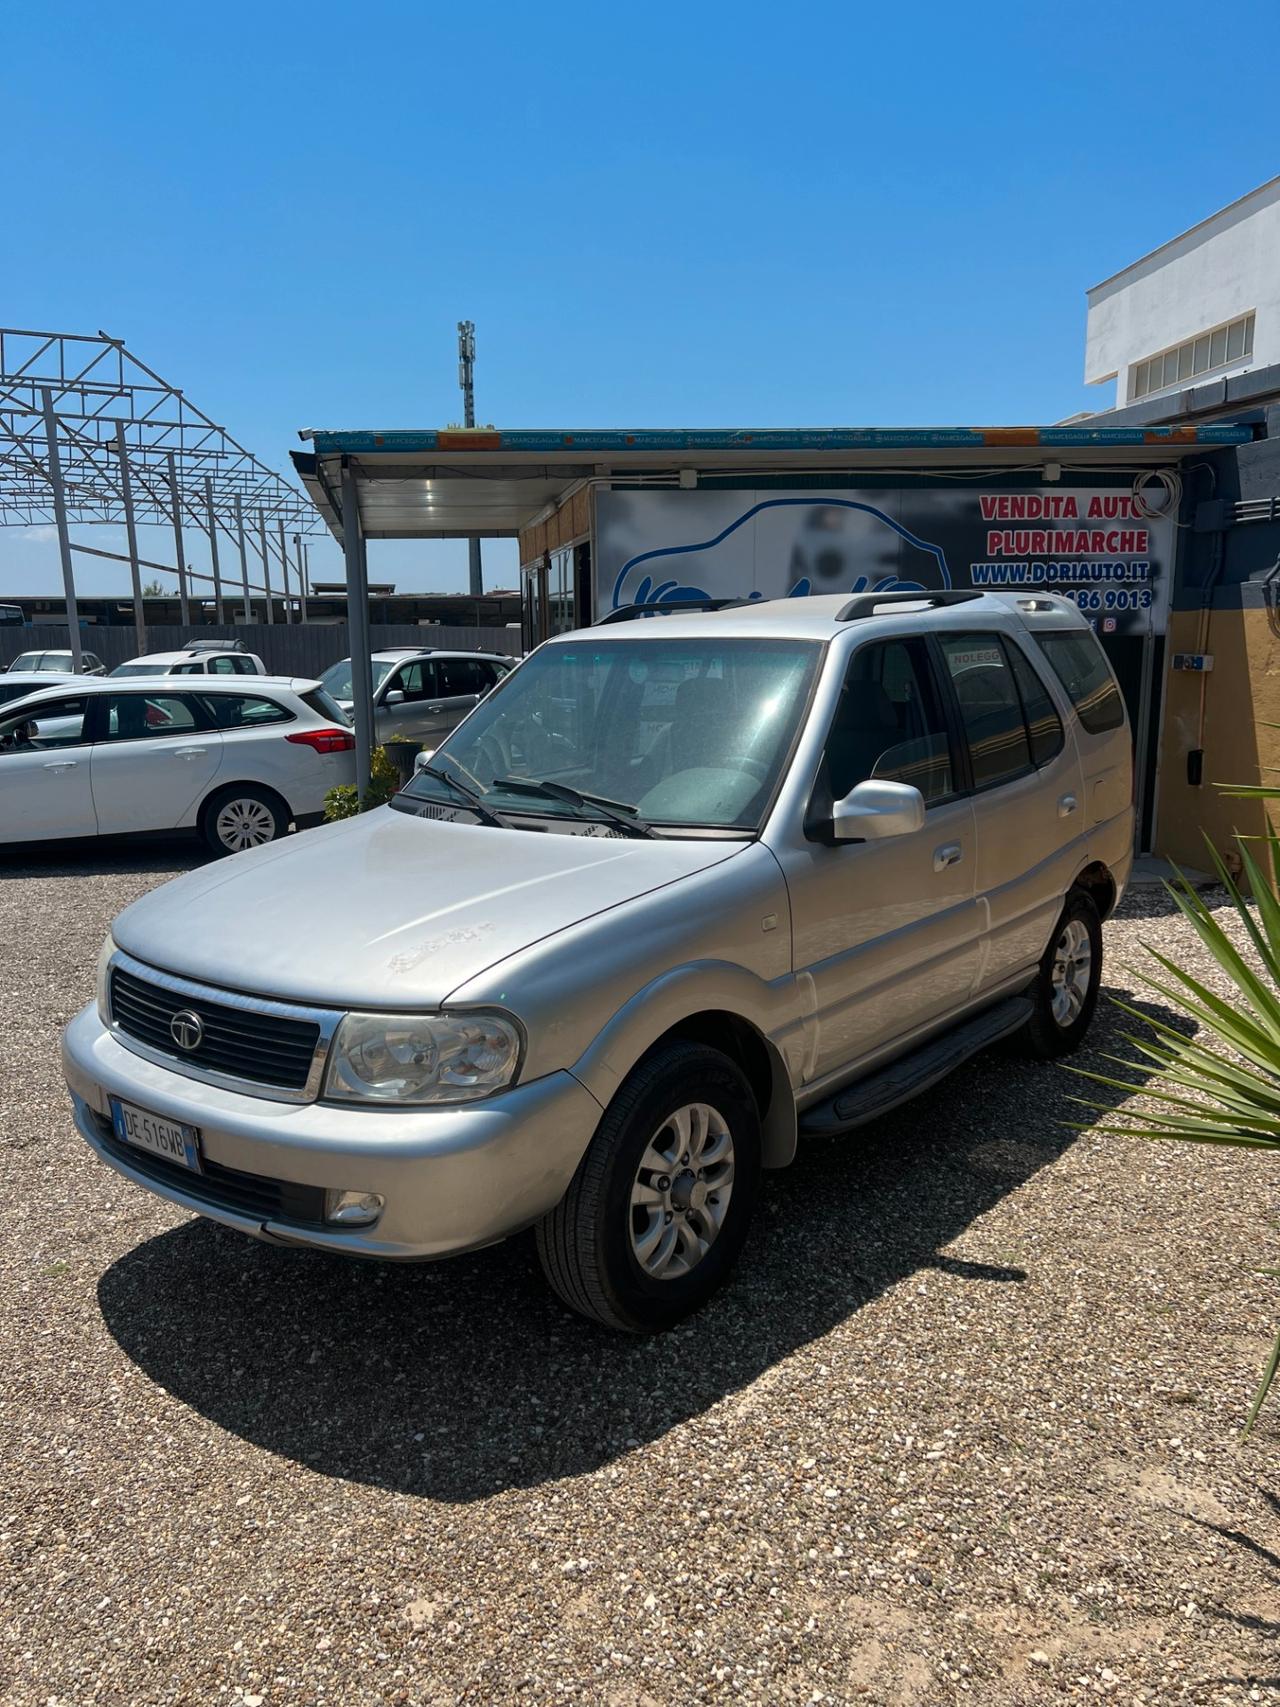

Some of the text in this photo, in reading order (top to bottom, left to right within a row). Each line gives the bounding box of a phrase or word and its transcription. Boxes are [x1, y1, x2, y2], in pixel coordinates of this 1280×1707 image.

[979, 495, 1078, 520] VENDITA
[987, 530, 1150, 556] PLURIMARCHE
[970, 562, 1150, 585] WWW.DORIAUTO.IT
[1104, 589, 1152, 611] 9013
